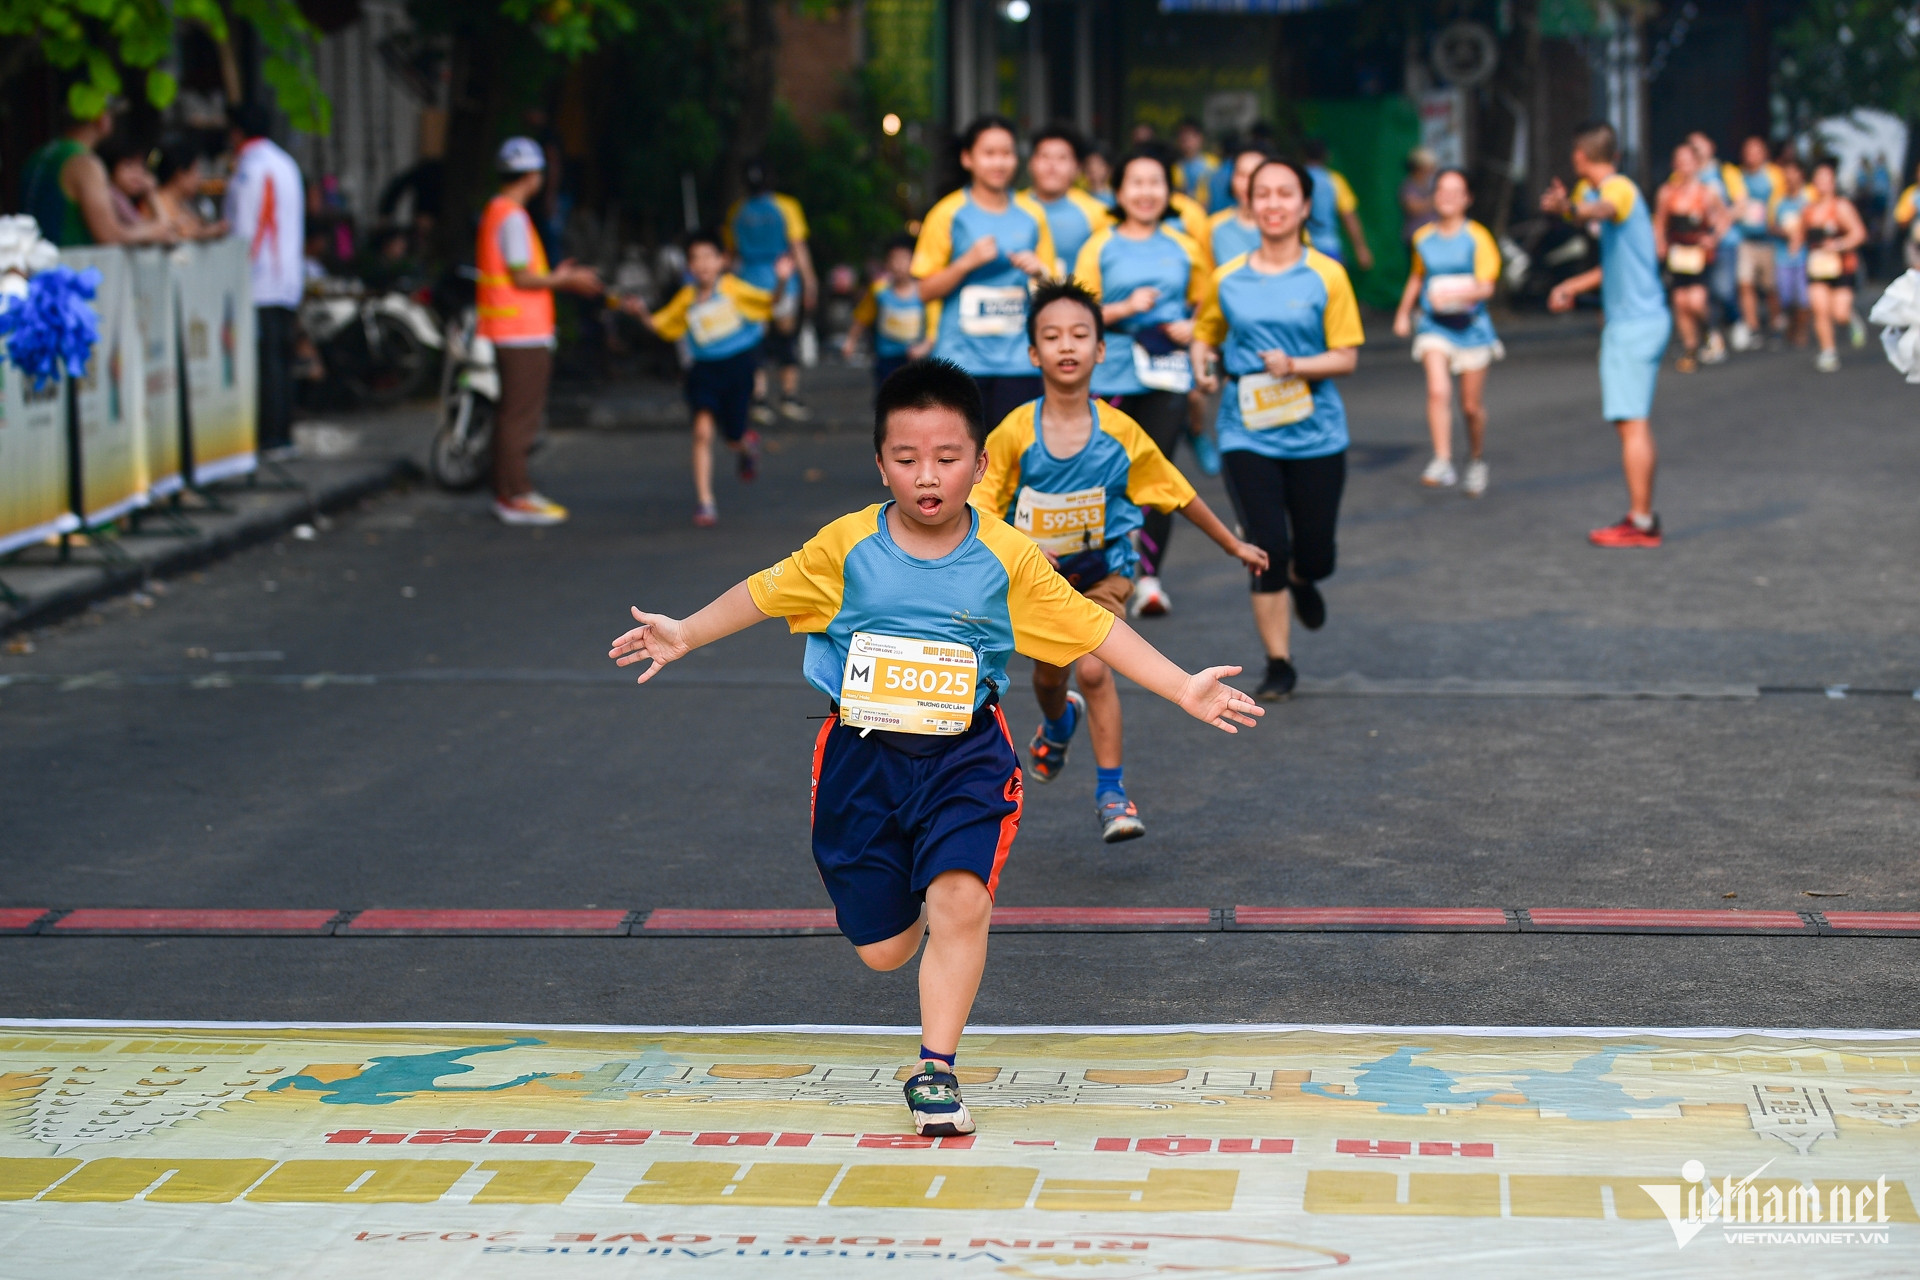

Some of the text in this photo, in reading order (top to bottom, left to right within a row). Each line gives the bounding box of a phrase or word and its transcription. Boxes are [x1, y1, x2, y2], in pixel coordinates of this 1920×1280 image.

[1018, 510, 1029, 523] M
[1042, 508, 1101, 530] 59533
[850, 663, 870, 683] M
[885, 666, 970, 696] 58025
[864, 715, 900, 724] 0919785998
[326, 1129, 977, 1149] 12.10.2024
[624, 1162, 1238, 1212] FOR
[355, 1231, 1149, 1250] RUN FOR LOVE 2024
[735, 1248, 1006, 1264] Vietnam
